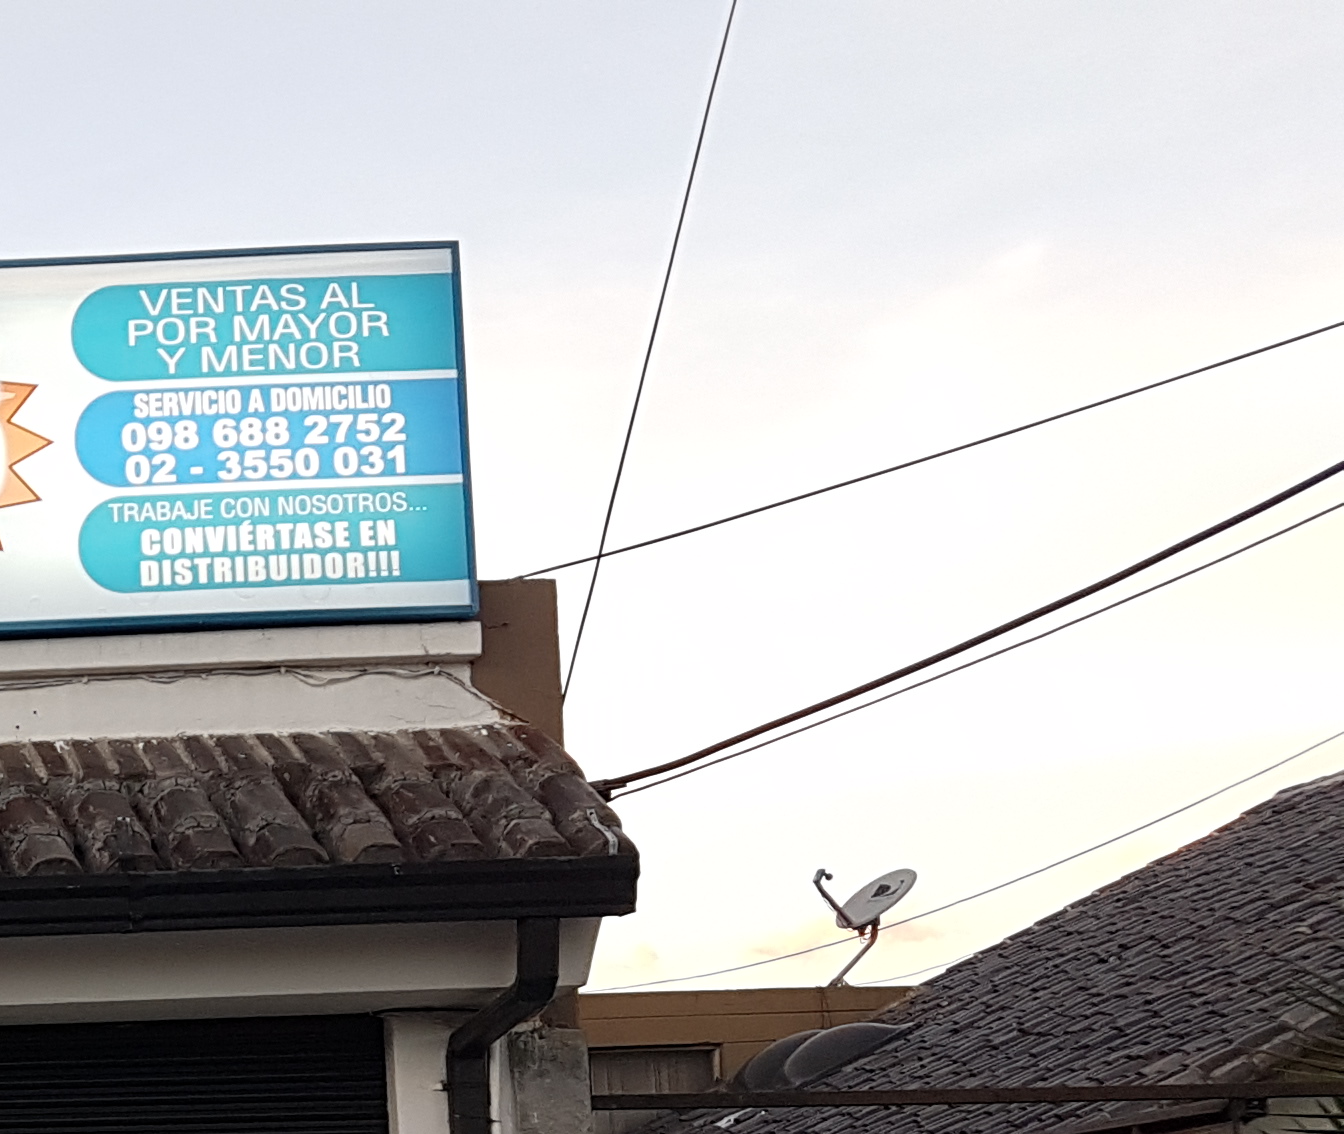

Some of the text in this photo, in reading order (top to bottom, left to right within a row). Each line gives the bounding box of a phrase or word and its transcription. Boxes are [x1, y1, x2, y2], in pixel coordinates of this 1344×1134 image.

[139, 282, 375, 316] VENTAS AL
[127, 310, 390, 347] POR MAYOR
[156, 341, 361, 374] Y MENOR
[133, 383, 392, 418] SERVICIO A DOMICILIO
[121, 412, 407, 452] 098 688 2752
[125, 453, 177, 485] 02
[217, 448, 320, 480] 3550
[333, 445, 406, 476] 031
[108, 492, 428, 523] TRABAJE CON NOSOTROS...
[140, 519, 396, 556] CONVIÉRTASE EN
[139, 550, 401, 587] DISTRIBUIDOR!!!
